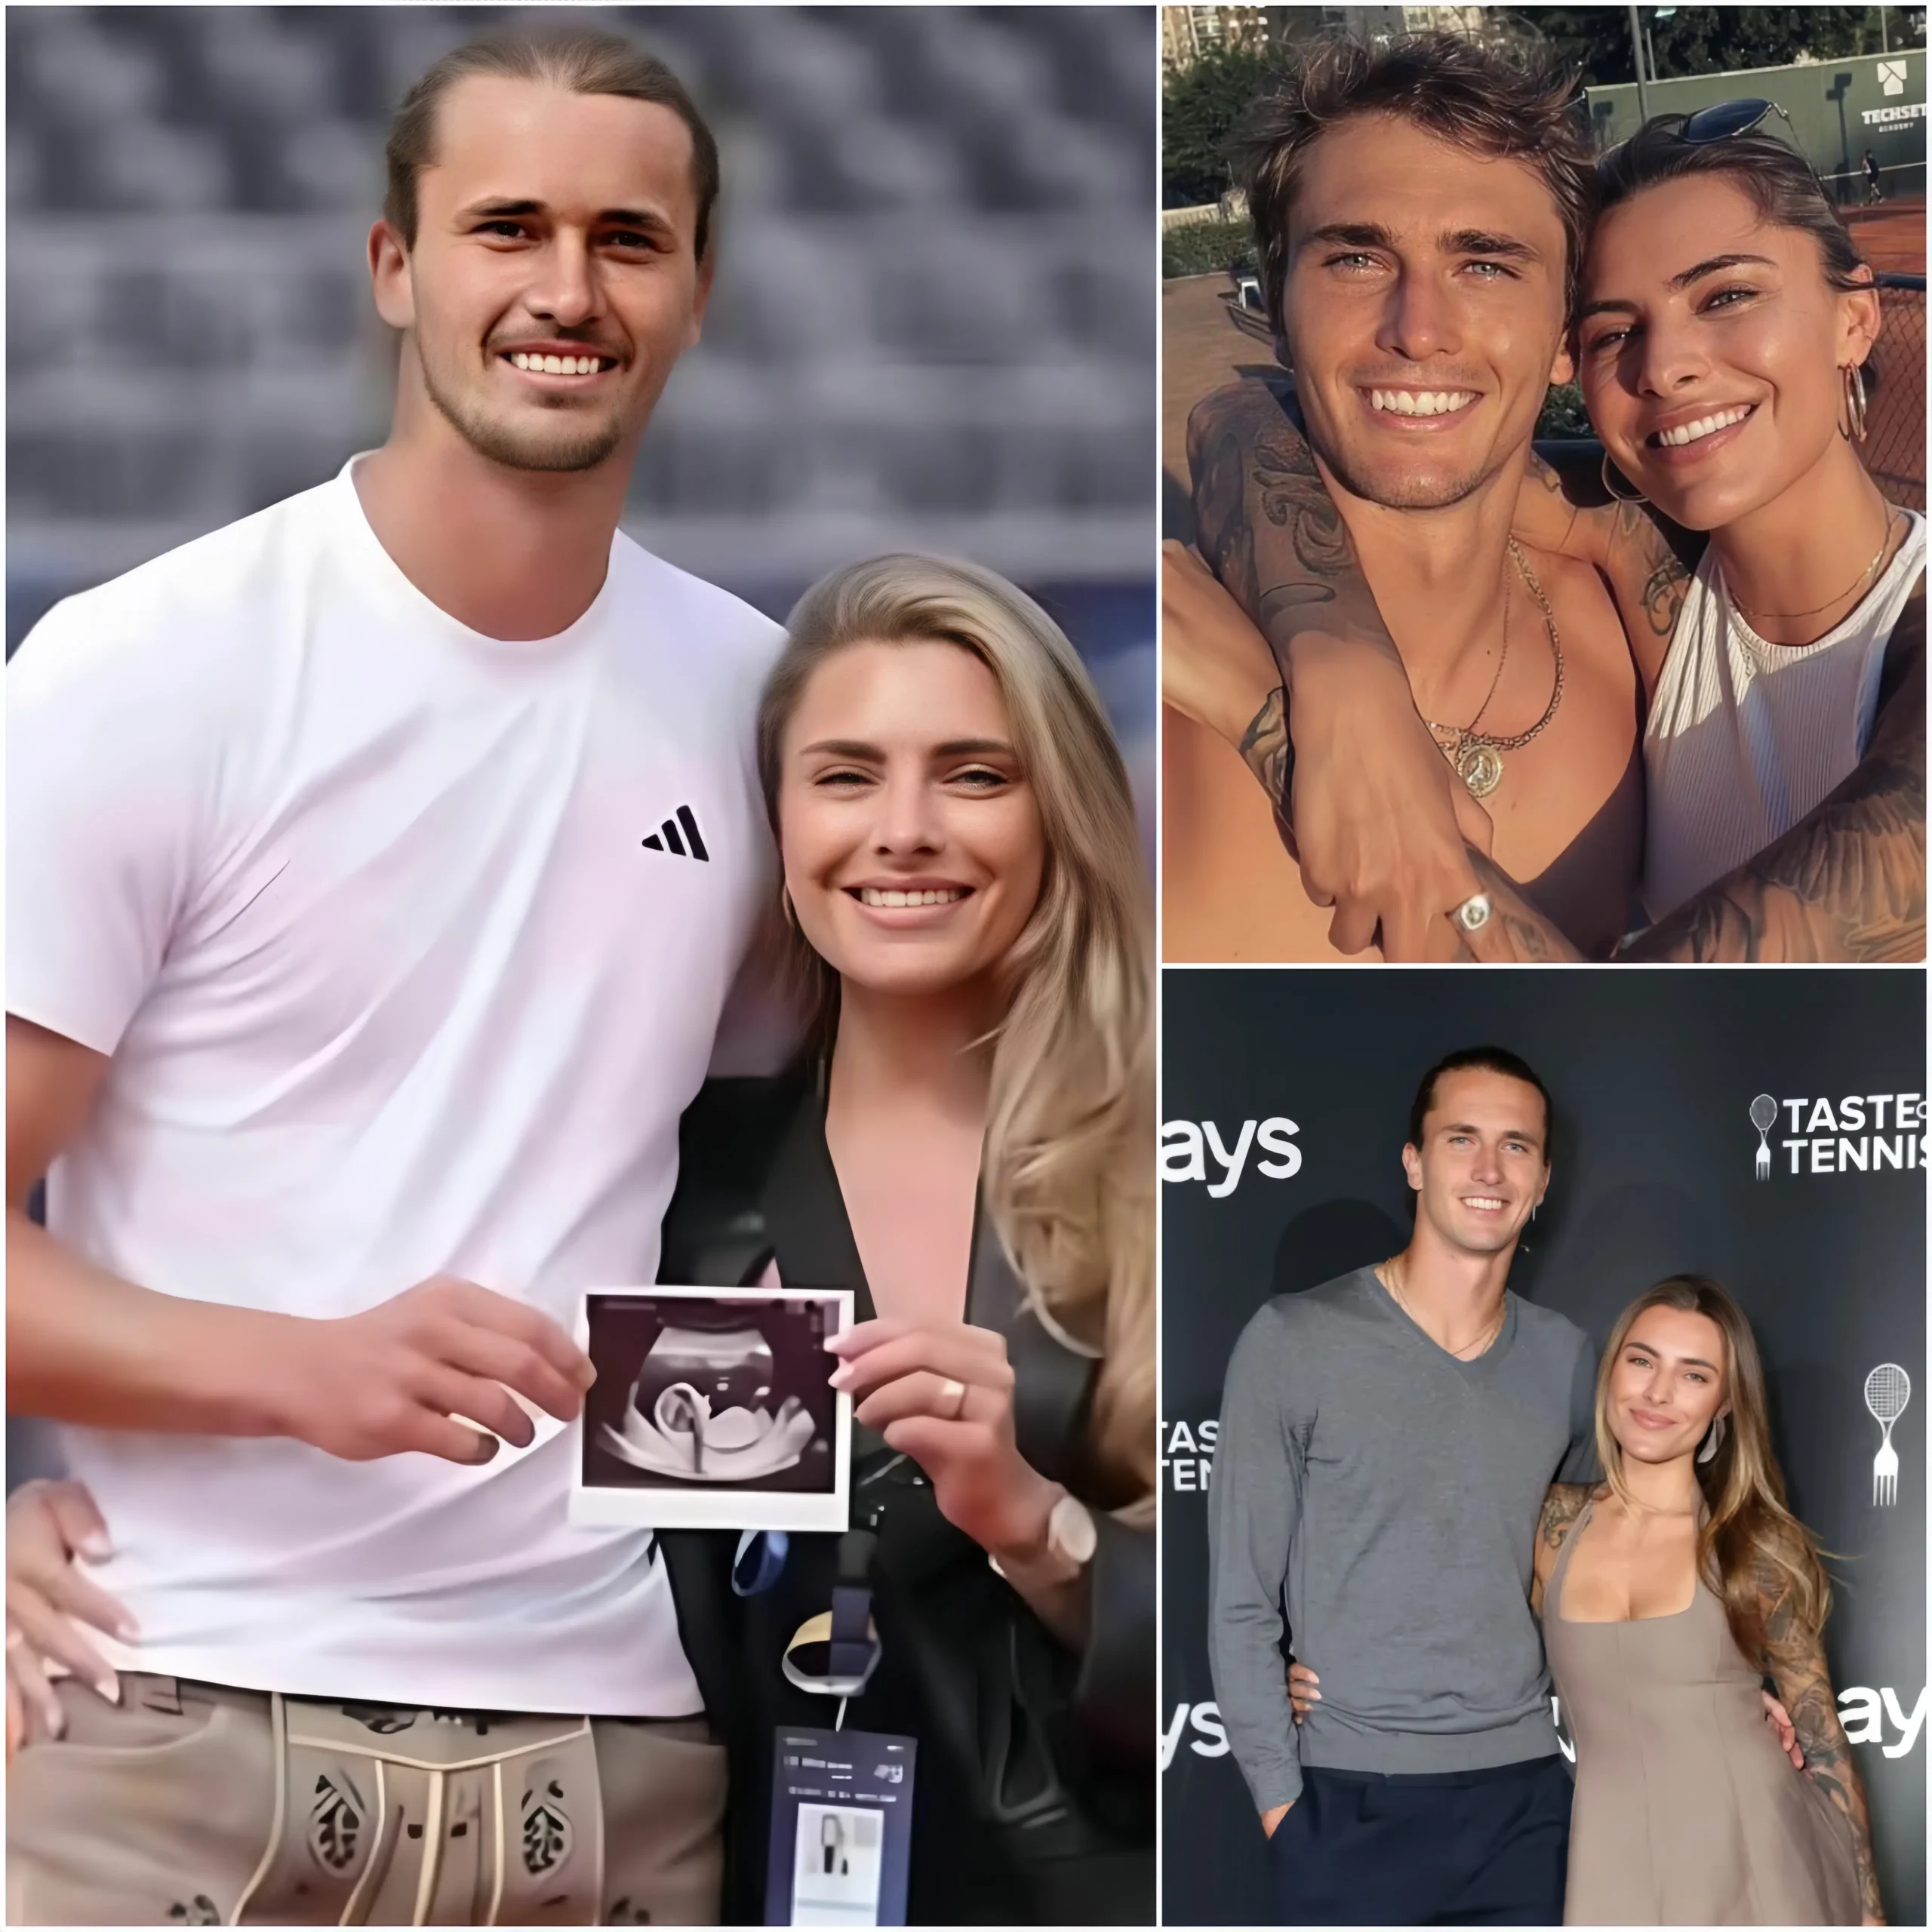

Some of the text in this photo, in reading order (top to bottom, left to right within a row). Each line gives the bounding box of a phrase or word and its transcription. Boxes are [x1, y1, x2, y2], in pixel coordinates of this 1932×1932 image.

[1783, 1093, 1920, 1133] TASTE
[1162, 1117, 1303, 1198] ays
[1782, 1134, 1927, 1174] TENNI
